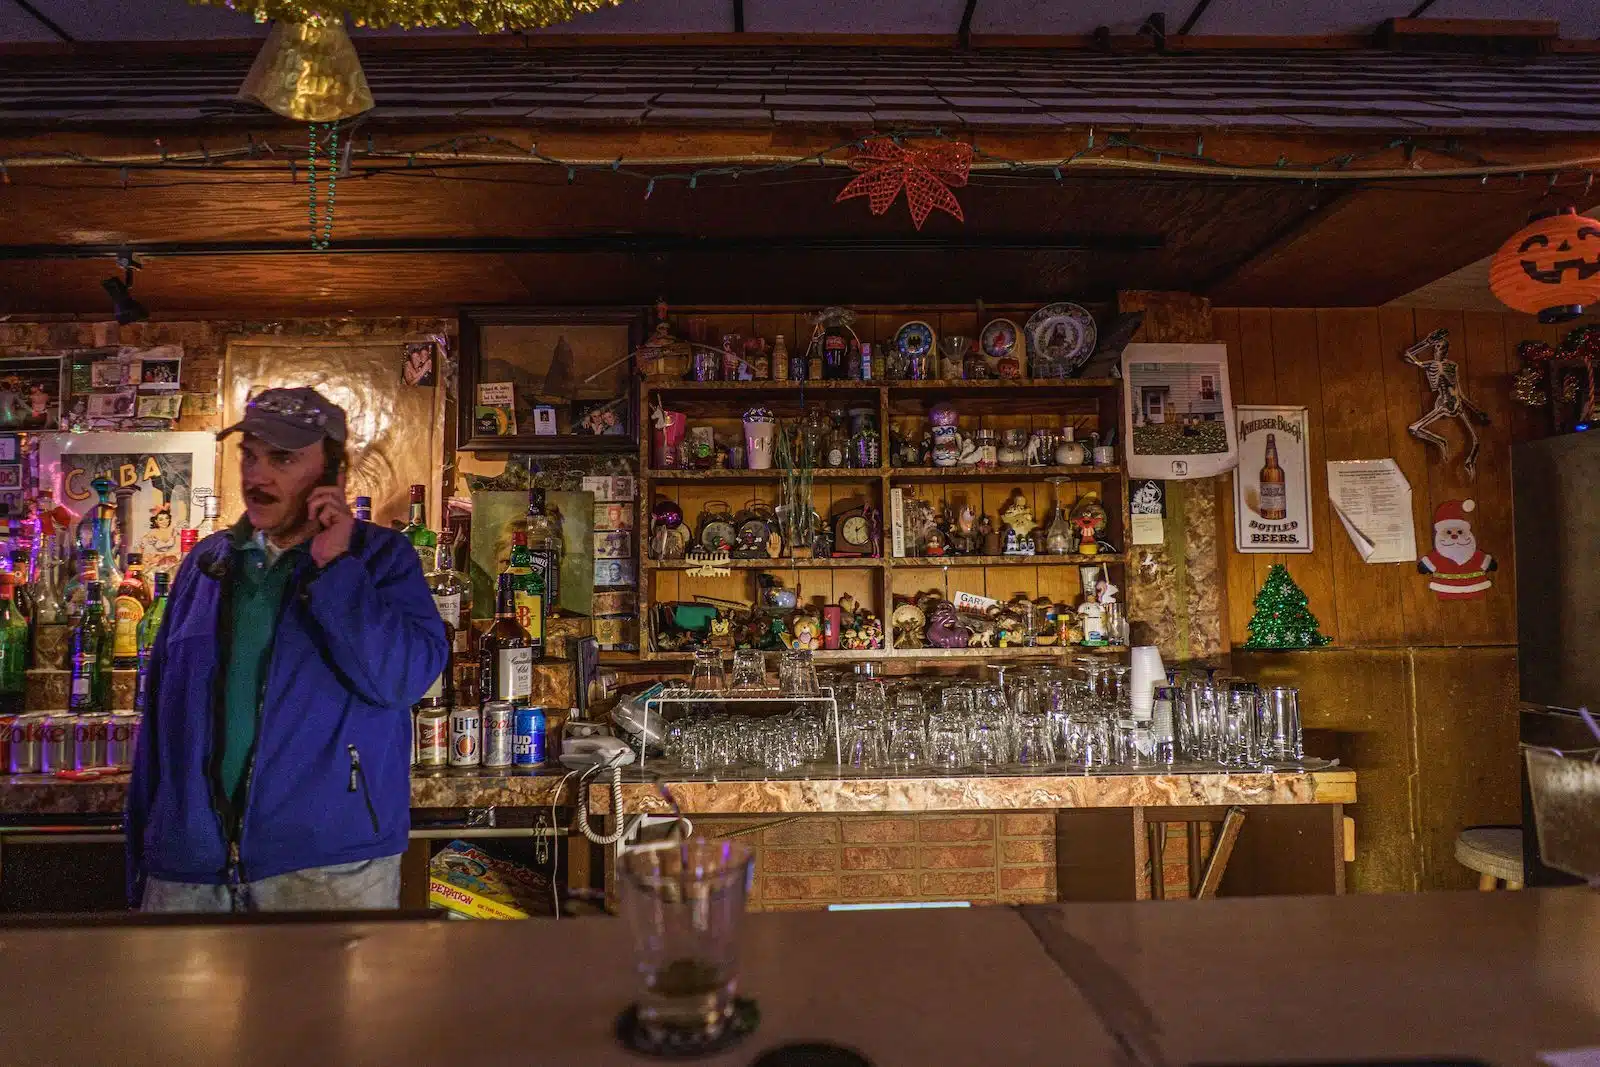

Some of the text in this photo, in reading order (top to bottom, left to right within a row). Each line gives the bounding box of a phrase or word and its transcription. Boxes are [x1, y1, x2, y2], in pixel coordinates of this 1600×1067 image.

[64, 456, 162, 501] CBA
[1248, 520, 1298, 532] BOTTLED
[1250, 534, 1300, 544] BEERS.
[960, 593, 986, 605] GARY
[453, 717, 479, 733] Lite
[513, 744, 538, 755] GHT
[430, 882, 473, 905] PERATION
